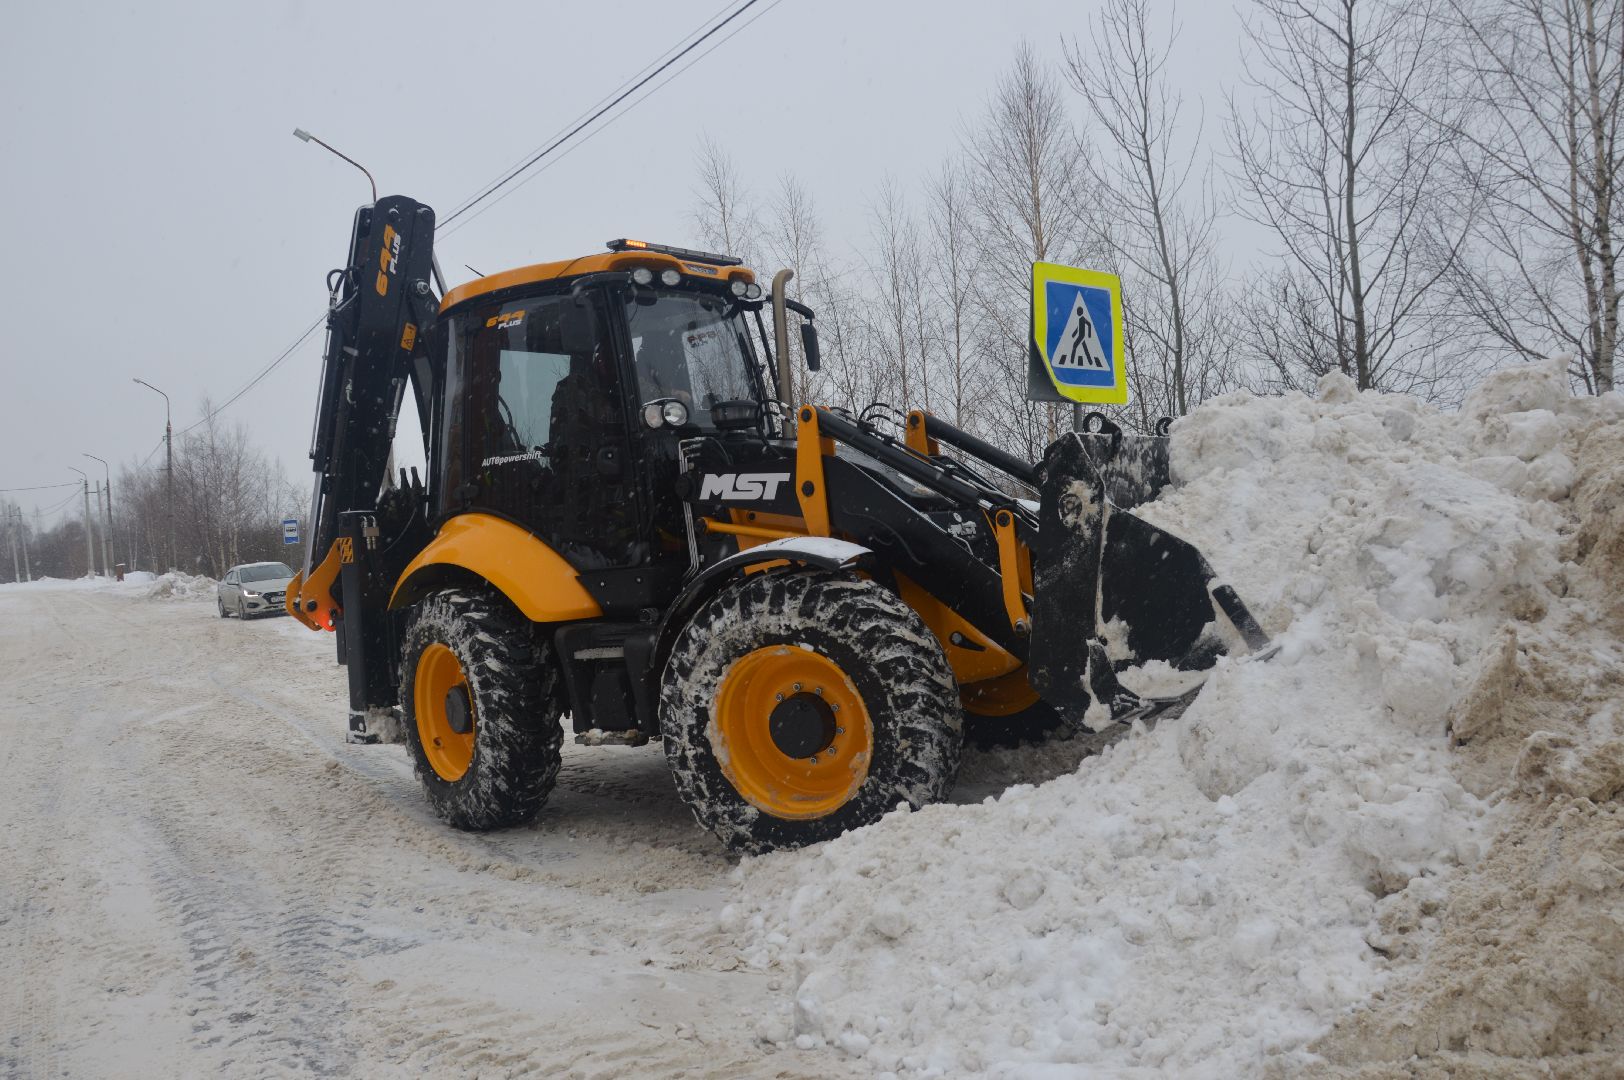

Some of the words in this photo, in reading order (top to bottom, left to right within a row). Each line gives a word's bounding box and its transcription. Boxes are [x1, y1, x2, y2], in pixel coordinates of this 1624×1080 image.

[389, 232, 402, 275] PLUS
[497, 320, 522, 330] PLUS
[699, 472, 791, 500] MST
